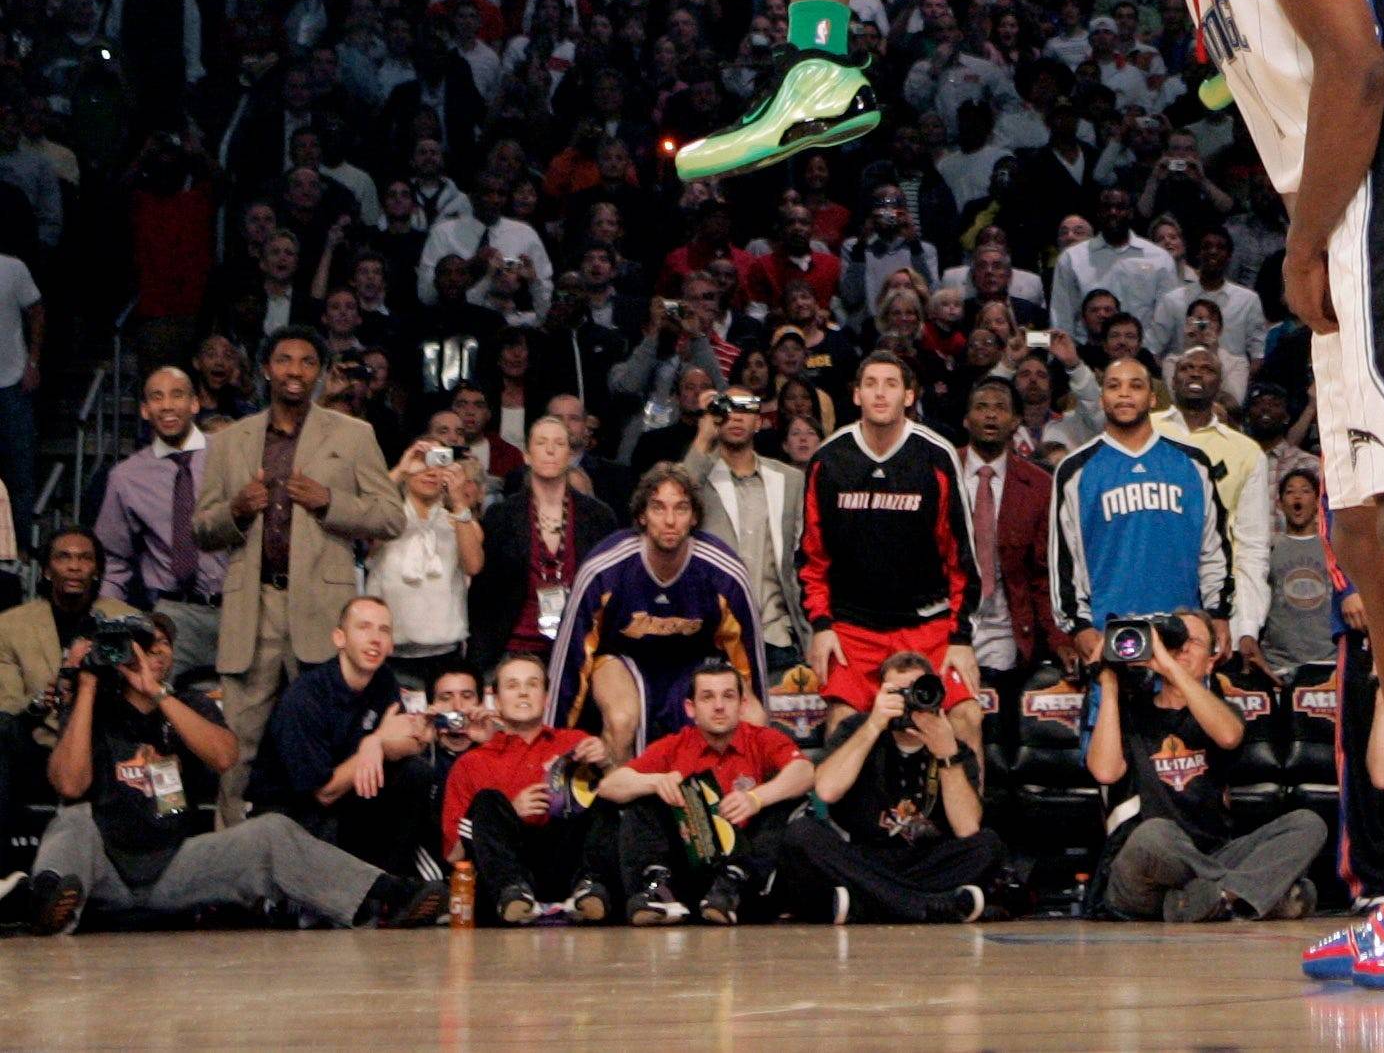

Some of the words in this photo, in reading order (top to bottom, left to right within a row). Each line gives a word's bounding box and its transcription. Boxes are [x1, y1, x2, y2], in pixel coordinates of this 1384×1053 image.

[837, 492, 870, 509] TRAIL
[871, 493, 922, 512] BLAZERS
[1102, 482, 1183, 522] MAGIC
